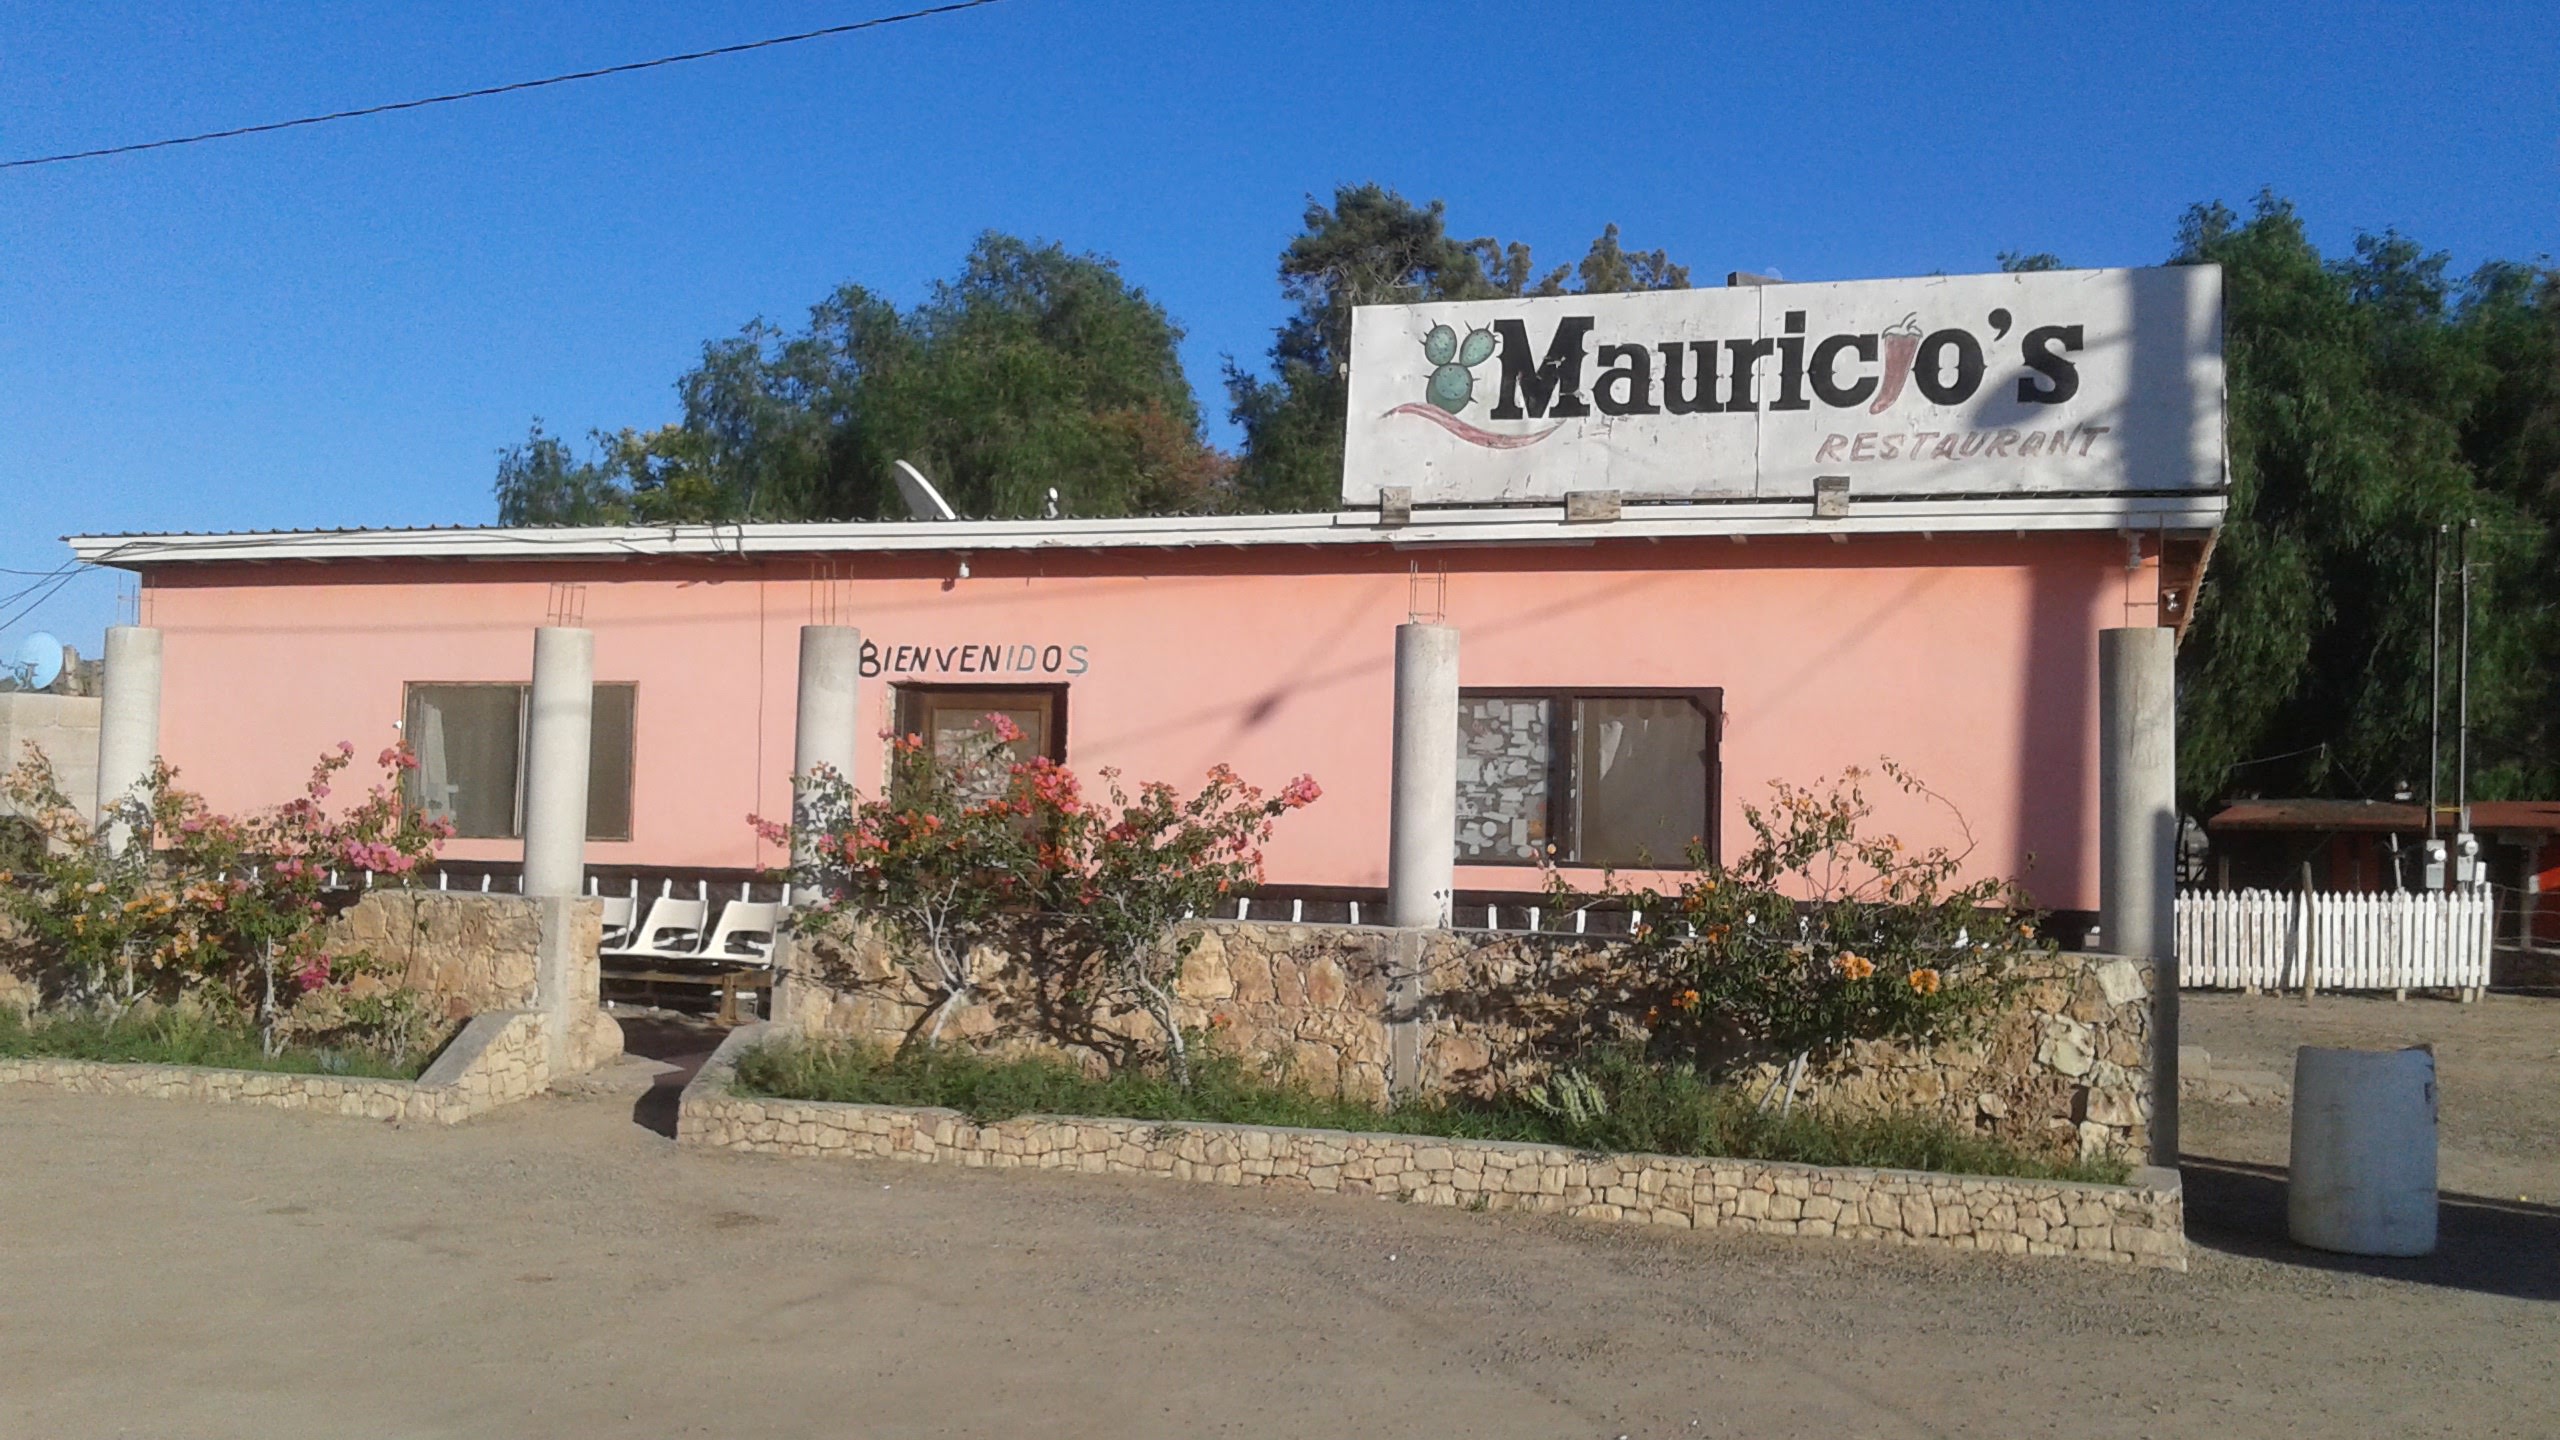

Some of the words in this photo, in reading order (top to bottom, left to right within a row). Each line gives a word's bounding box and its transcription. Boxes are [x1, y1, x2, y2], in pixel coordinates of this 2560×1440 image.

[1490, 308, 2084, 420] Mauricio's
[1814, 423, 2110, 463] RESTAURANT
[859, 639, 1089, 677] BIENVENIDOS
